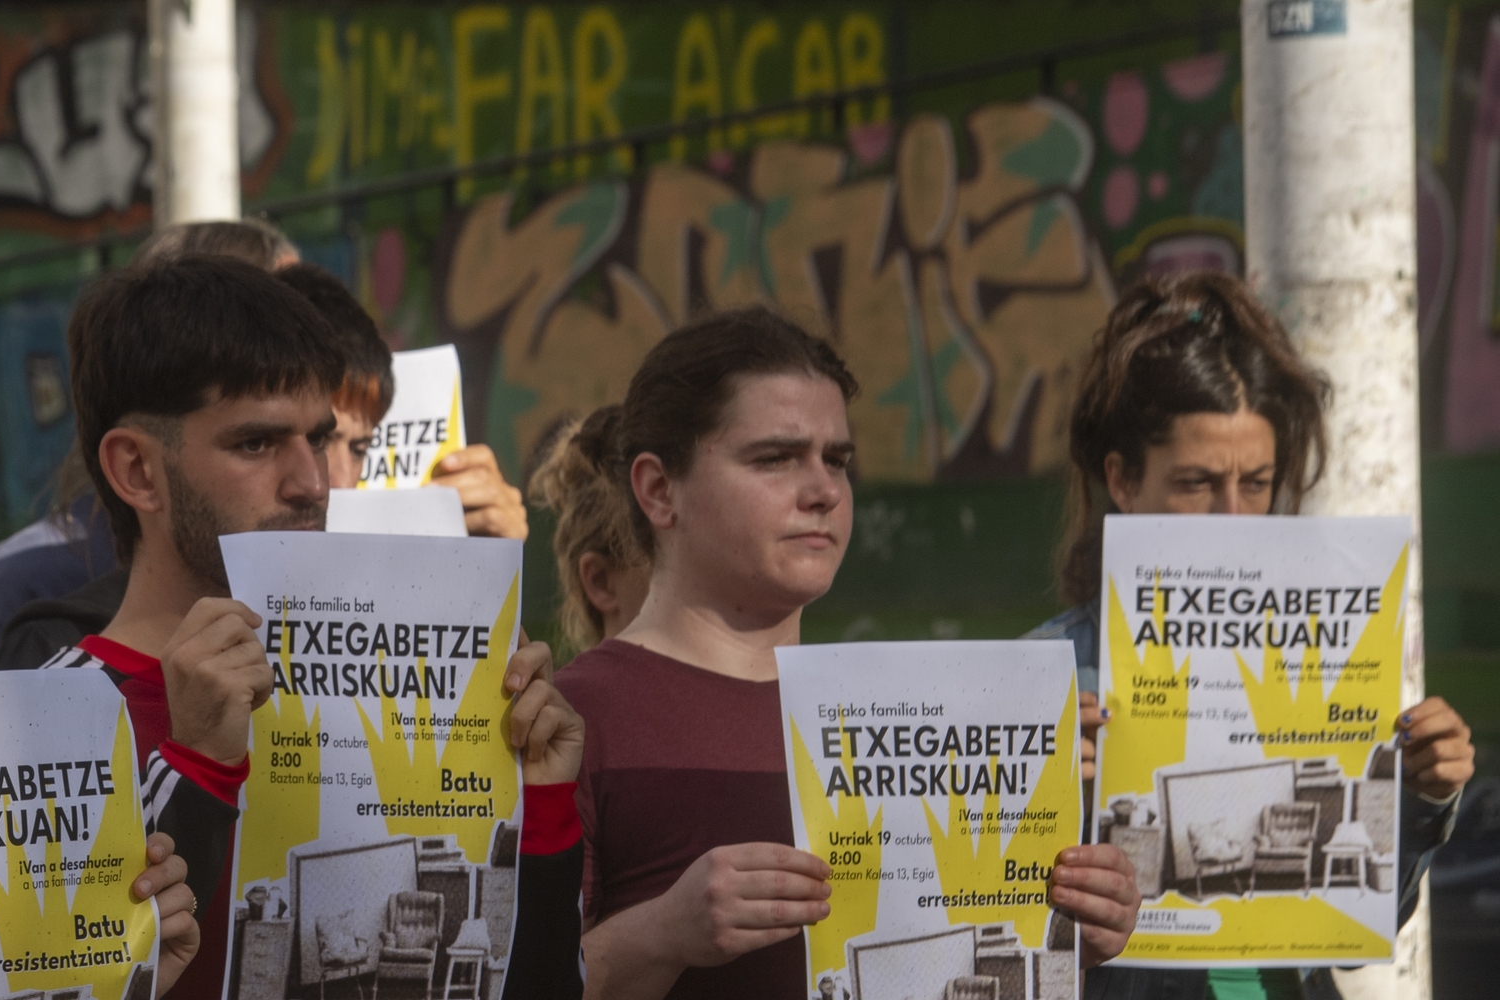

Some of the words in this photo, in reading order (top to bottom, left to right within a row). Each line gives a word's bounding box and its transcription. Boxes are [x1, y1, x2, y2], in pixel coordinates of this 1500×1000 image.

[267, 595, 306, 614] Egiako
[310, 596, 350, 612] familia
[354, 598, 375, 613] bat
[265, 620, 489, 659] ETXEGABETZE
[271, 662, 456, 700] ARRISKUAN!
[419, 718, 425, 726] a
[429, 713, 490, 727] desahuciar
[818, 703, 866, 721] Egiako
[871, 702, 917, 716] familia
[922, 702, 943, 716] bat
[272, 731, 312, 747] Urriak
[316, 732, 329, 747] 19
[333, 736, 368, 748] octubre
[395, 732, 400, 740] a
[403, 732, 419, 740] una
[421, 729, 450, 741] familia
[453, 730, 463, 741] de
[466, 730, 490, 745] Egia!
[821, 724, 1056, 758] ETXEGABETZE
[271, 752, 301, 767] 8:00
[270, 771, 304, 784] Baztan
[307, 772, 333, 785] Kalea
[336, 773, 348, 786] 13,
[351, 773, 371, 789] Egia
[441, 768, 491, 792] Batu
[826, 762, 1027, 797] ARRISKUAN!
[357, 798, 493, 817] erresistentziara!
[986, 812, 993, 821] a
[996, 808, 1058, 820] desahuciar
[829, 831, 873, 846] Urriak
[878, 831, 891, 845] 19
[895, 833, 932, 845] octubre
[50, 863, 56, 872] a
[60, 855, 124, 872] desahuciar
[830, 851, 861, 865] 8:00
[866, 868, 894, 880] Kalea
[897, 868, 909, 881] 13,
[913, 868, 934, 883] Egia
[1005, 859, 1052, 881] Batu
[23, 882, 29, 890] a
[32, 880, 49, 889] una
[52, 874, 81, 887] familia
[84, 872, 95, 884] de
[98, 870, 122, 886] Egia!
[74, 915, 124, 940] Batu
